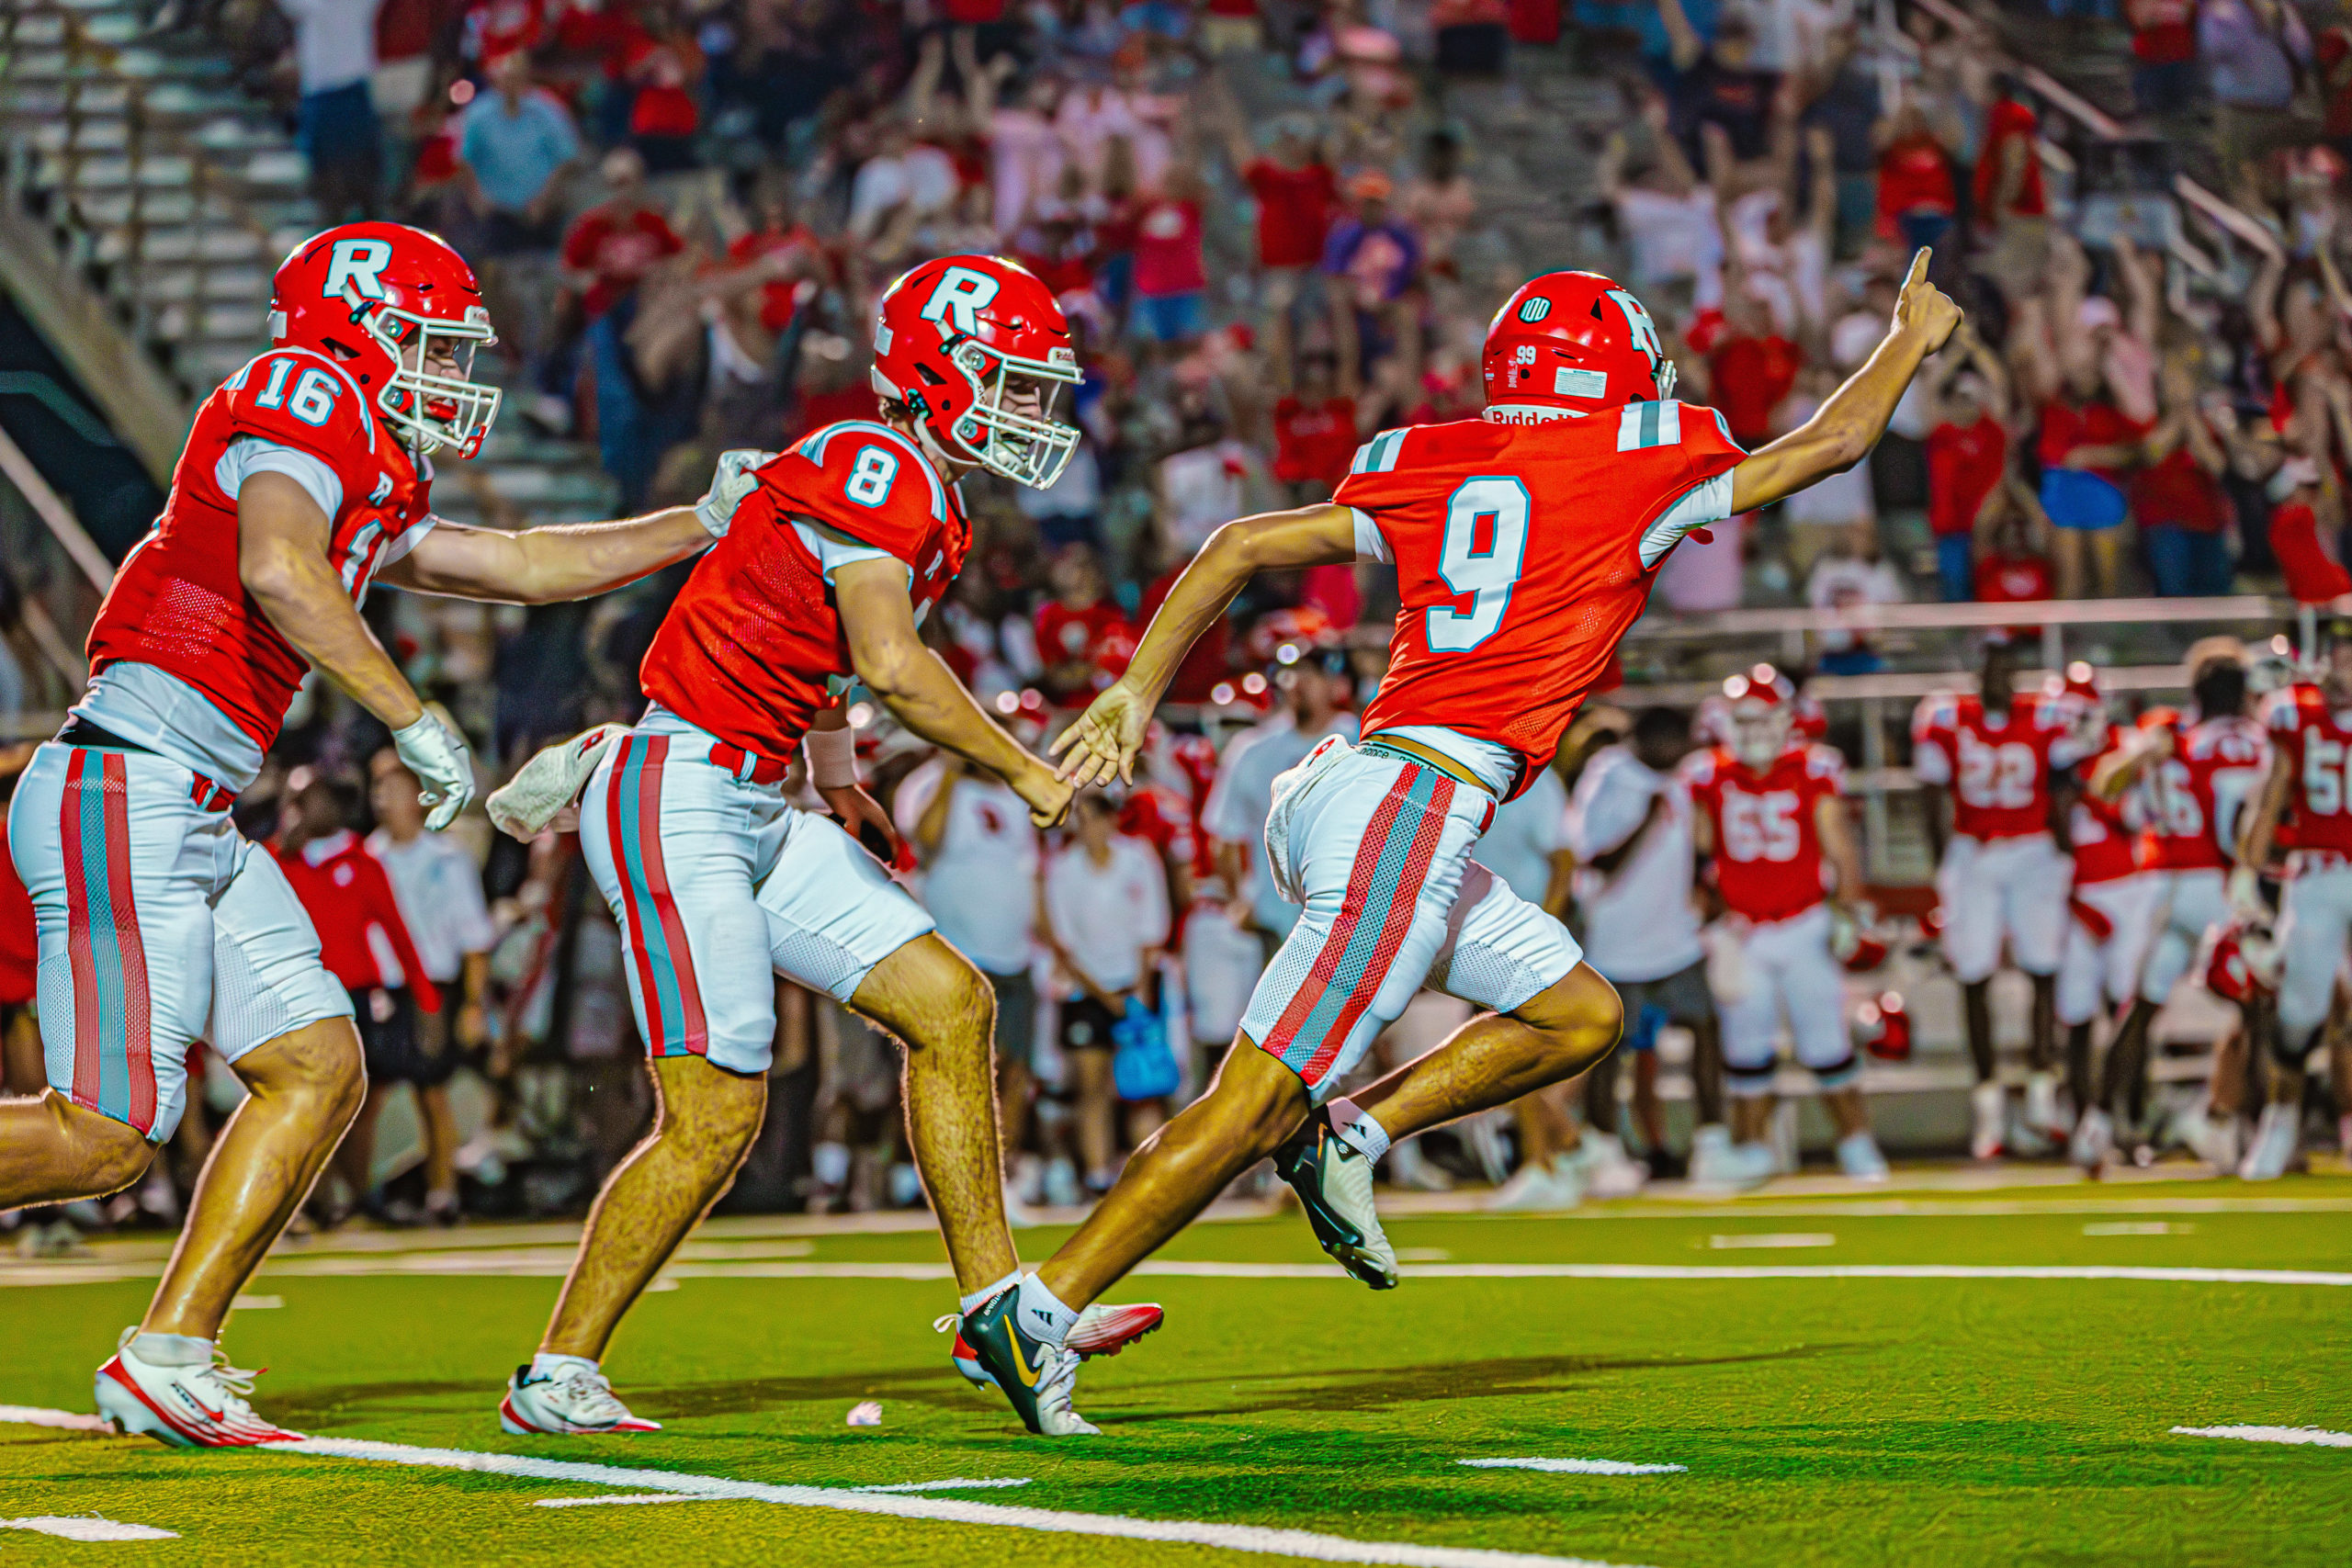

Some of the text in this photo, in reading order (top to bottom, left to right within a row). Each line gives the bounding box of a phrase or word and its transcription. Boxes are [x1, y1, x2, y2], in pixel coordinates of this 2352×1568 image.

[322, 238, 393, 300] R
[920, 265, 1001, 337] R
[1516, 344, 1537, 366] 99
[1603, 289, 1664, 355] R
[254, 357, 343, 427] 16
[844, 444, 900, 509] 8
[1426, 475, 1532, 653] 9
[1958, 739, 2038, 809] 22
[2303, 738, 2352, 817] 5
